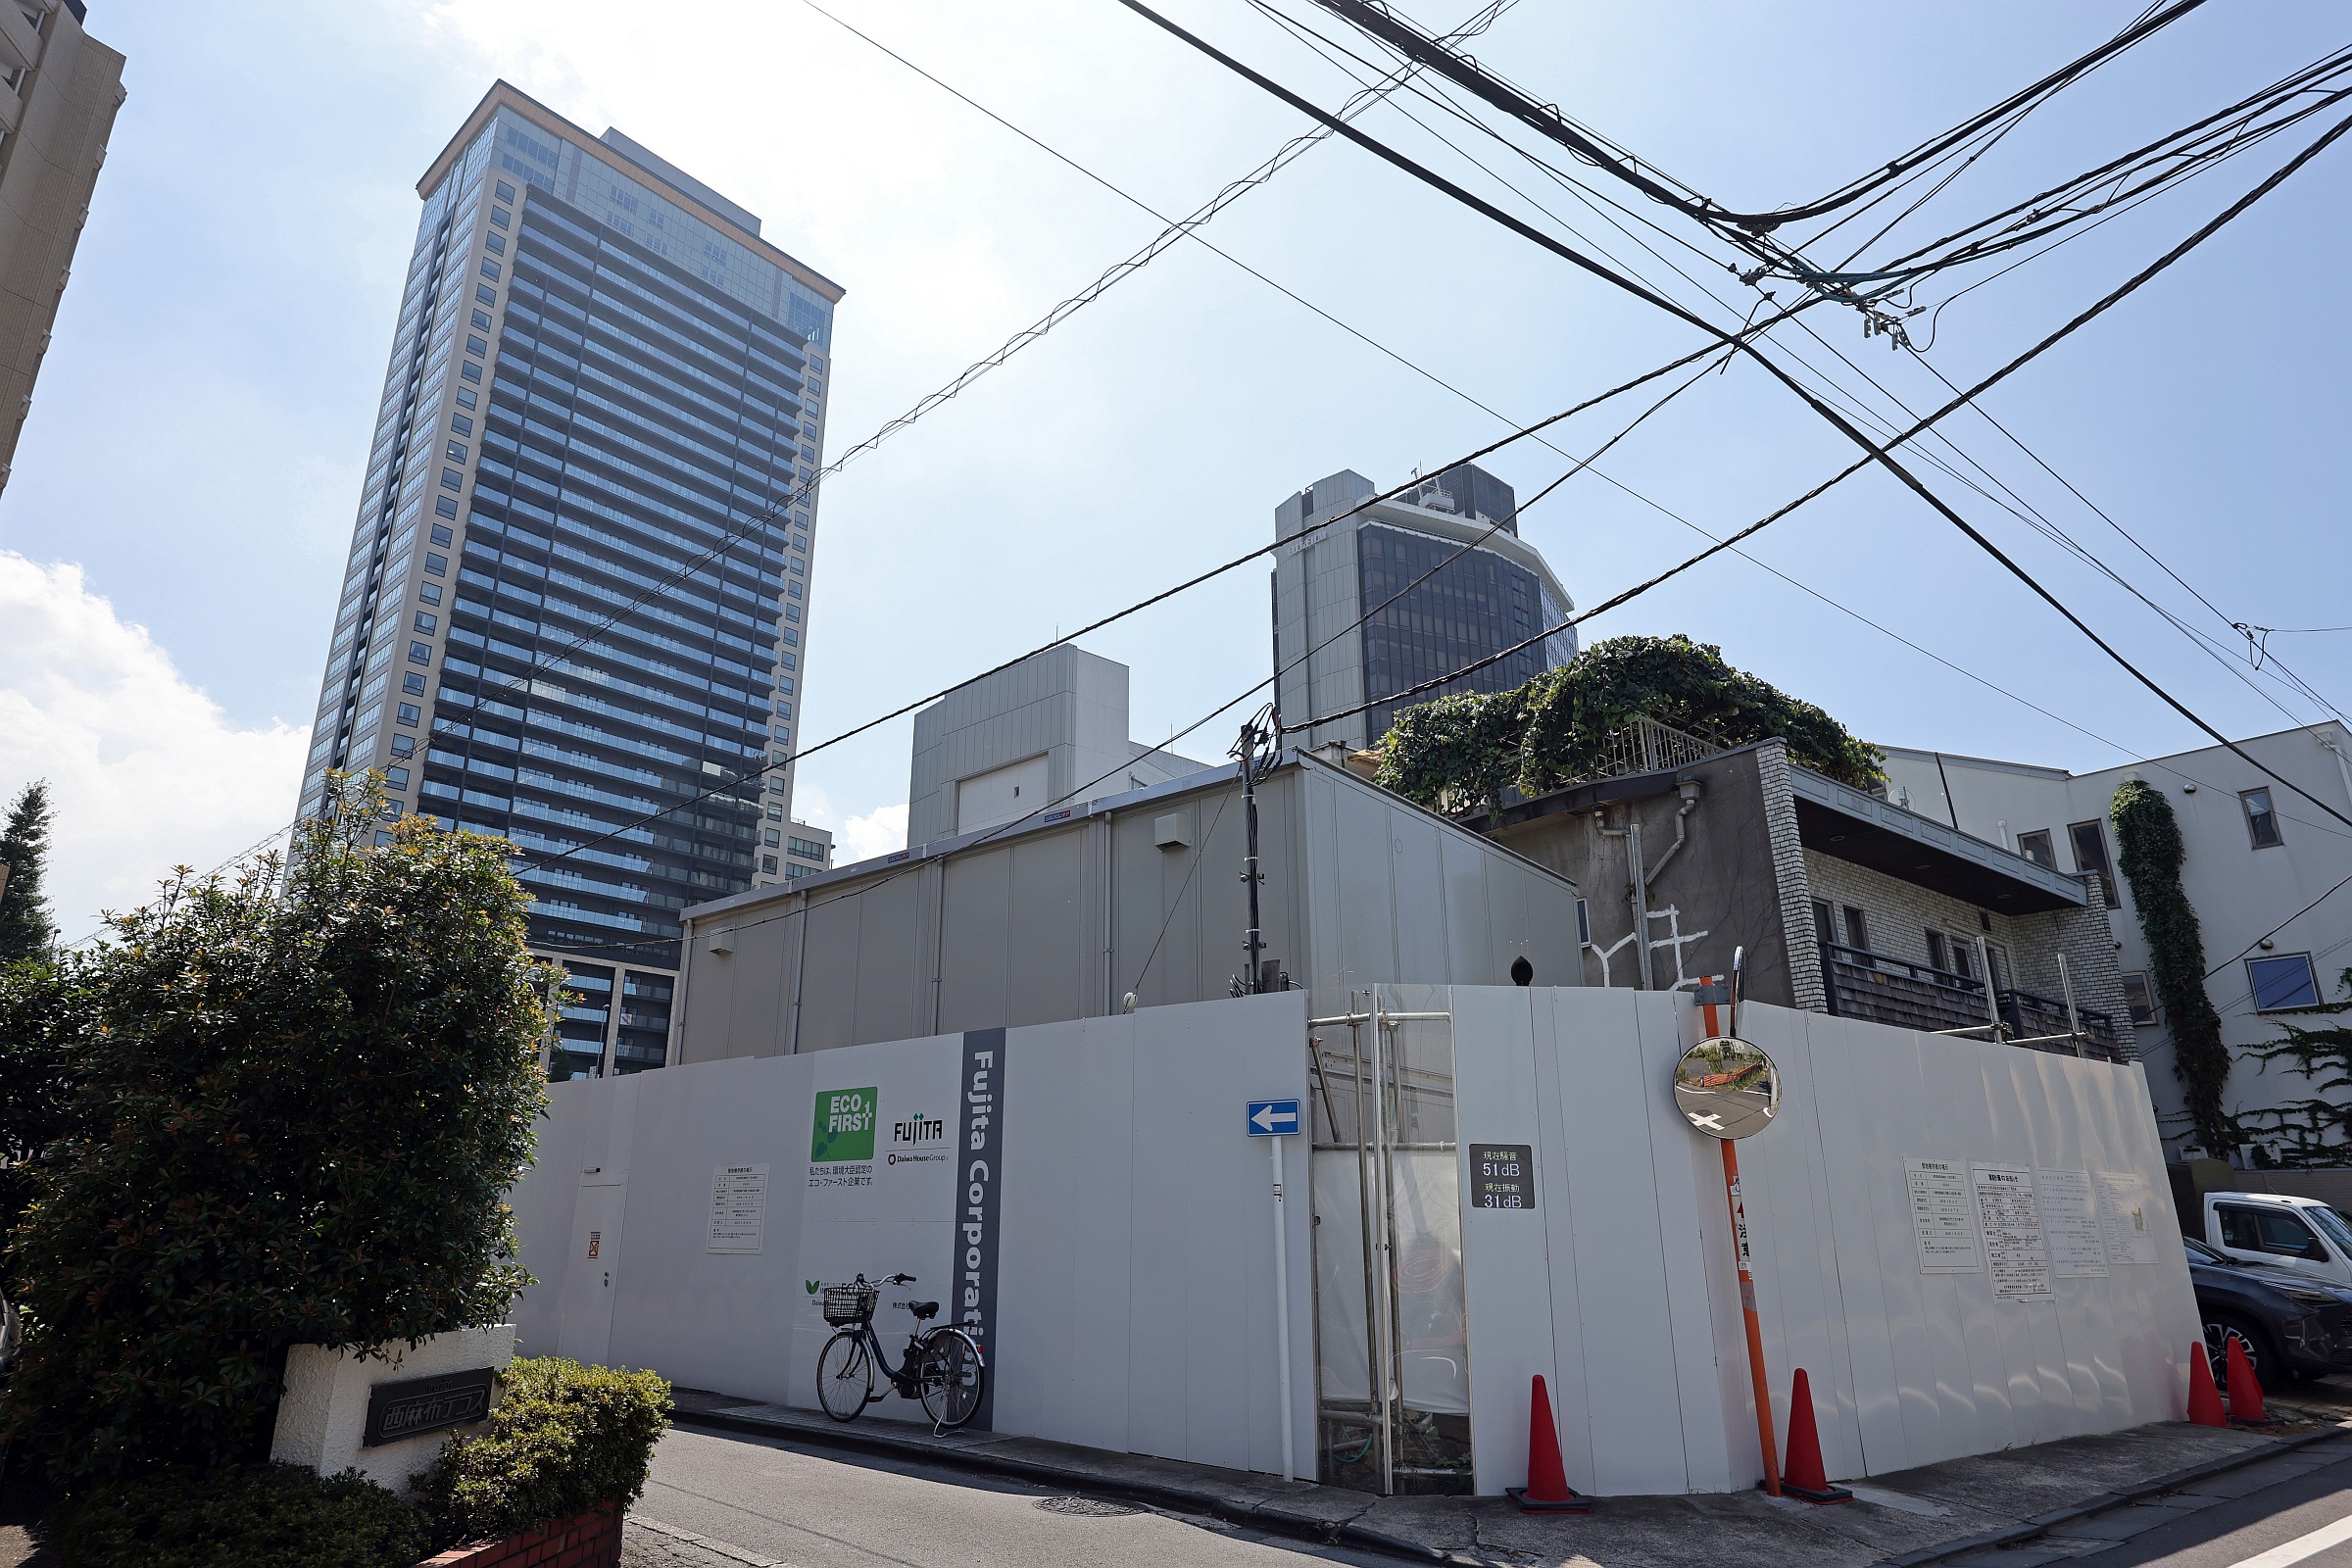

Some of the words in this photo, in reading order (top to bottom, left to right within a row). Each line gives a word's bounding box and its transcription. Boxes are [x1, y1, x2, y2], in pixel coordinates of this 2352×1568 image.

[830, 1094, 861, 1113] ECO
[967, 1051, 994, 1151] Fujita
[828, 1102, 873, 1133] FIRST
[894, 1113, 943, 1146] FUJITA
[1483, 1151, 1518, 1161] 現在騒音
[1485, 1182, 1520, 1193] 現在振動
[960, 1159, 990, 1387] Corporatin
